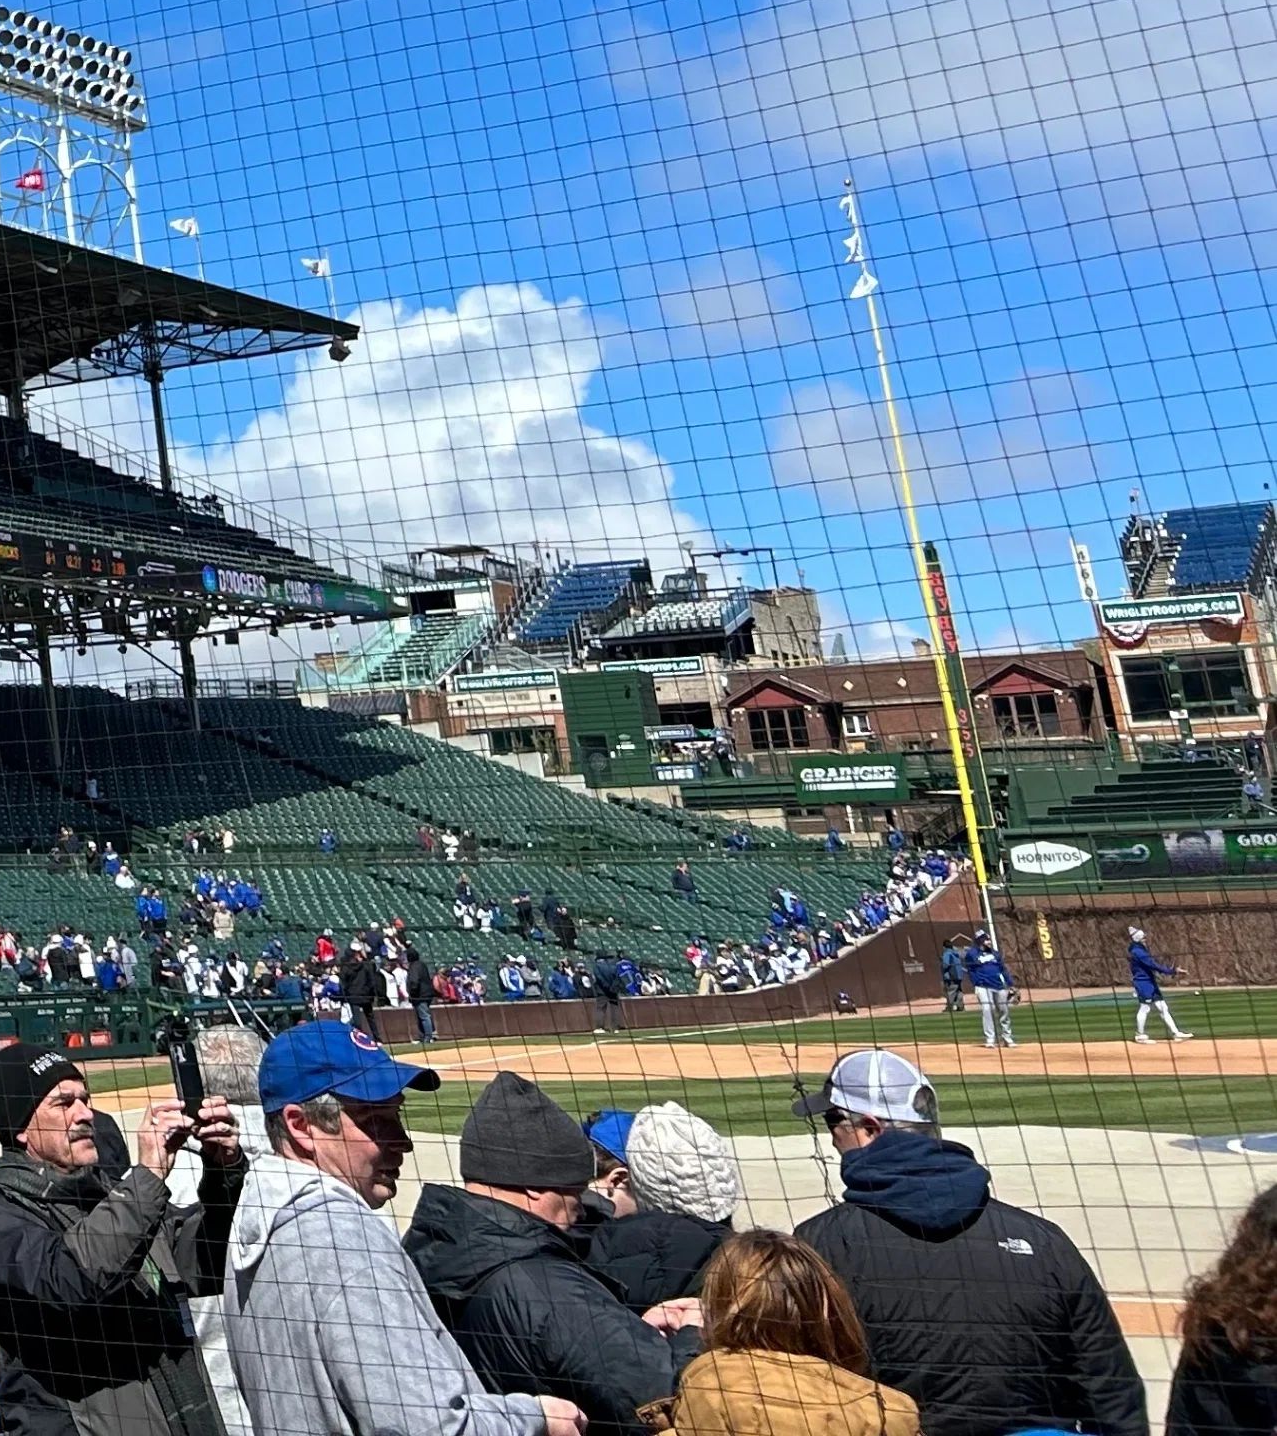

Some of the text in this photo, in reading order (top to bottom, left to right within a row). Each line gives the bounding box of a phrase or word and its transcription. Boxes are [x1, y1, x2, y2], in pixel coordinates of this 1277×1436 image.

[217, 568, 267, 598] DODGERS
[284, 578, 312, 605] CUBS
[928, 571, 949, 611] Hey
[937, 616, 958, 654] Hey
[957, 708, 974, 759] 355
[800, 765, 897, 783] GRAINGER
[1016, 850, 1081, 864] HORNITOS
[1236, 833, 1277, 848] GRO
